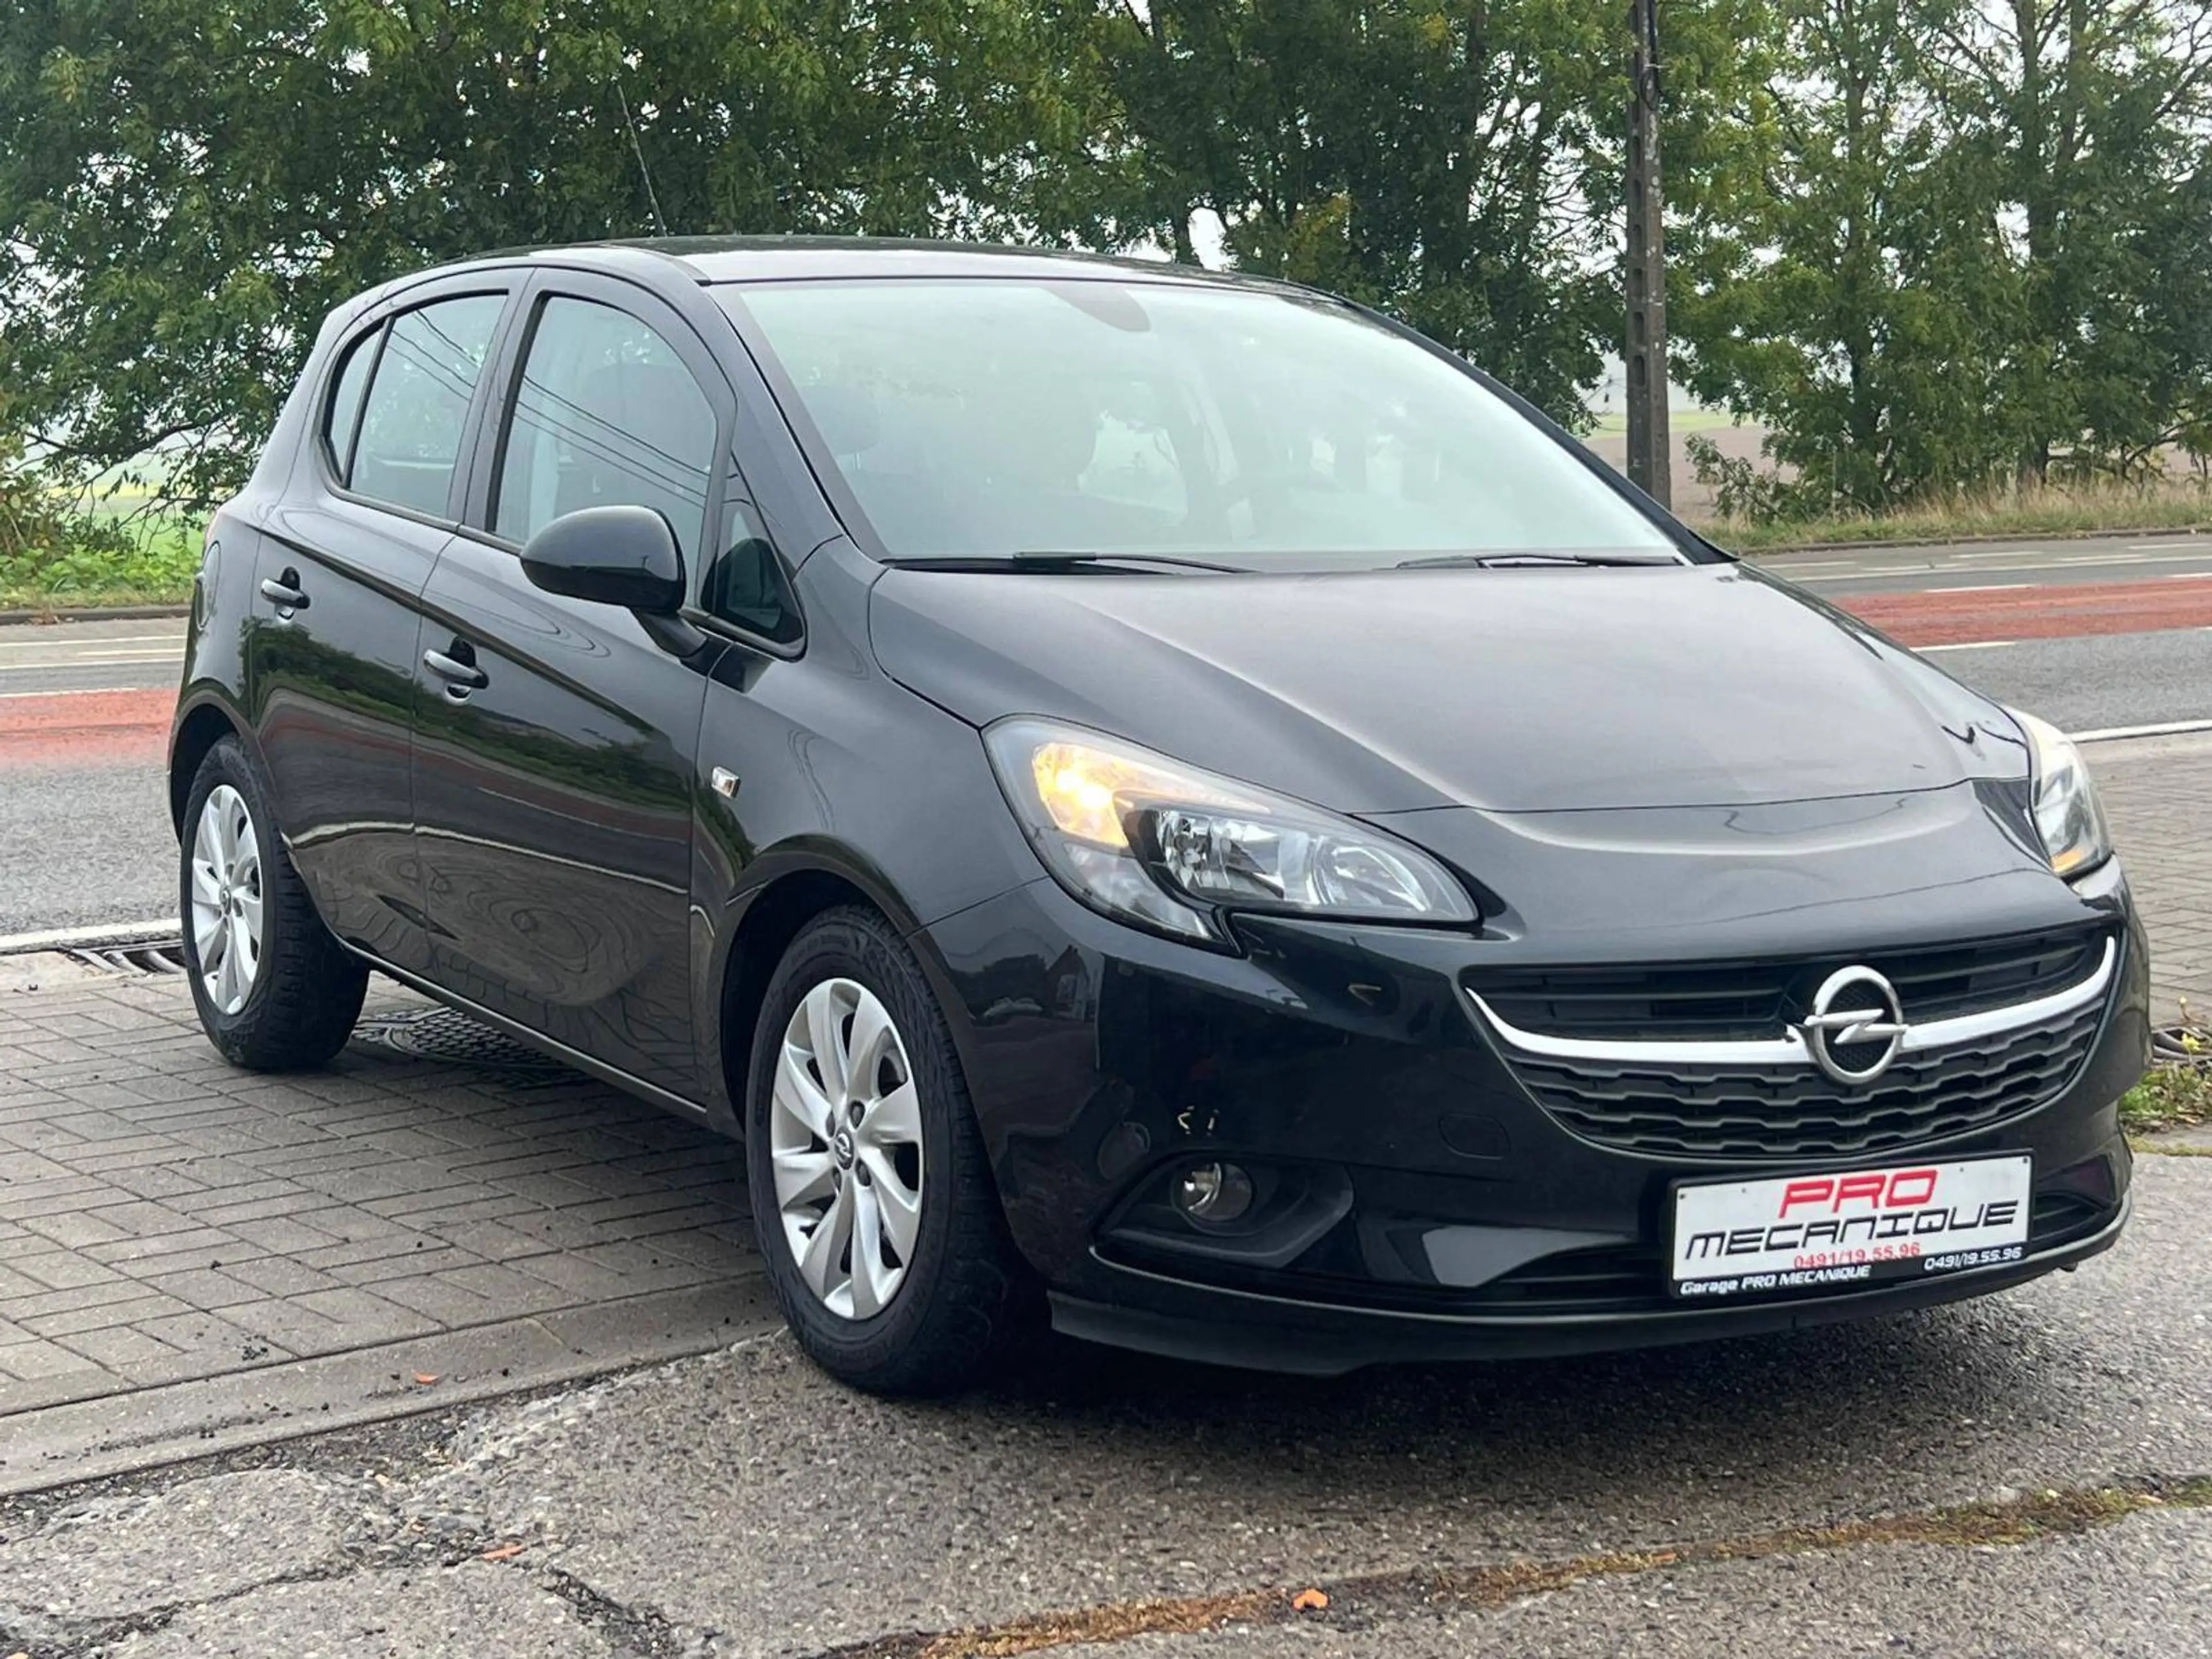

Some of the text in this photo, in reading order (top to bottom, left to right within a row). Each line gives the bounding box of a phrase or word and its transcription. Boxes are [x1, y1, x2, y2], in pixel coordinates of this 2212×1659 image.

[1778, 1169, 1938, 1218] PRO
[1684, 1200, 2018, 1260] MECANIQUE
[1794, 1241, 1921, 1268] 0491/19.55.96
[1680, 1265, 1872, 1296] Garage PRO MECANIQUE
